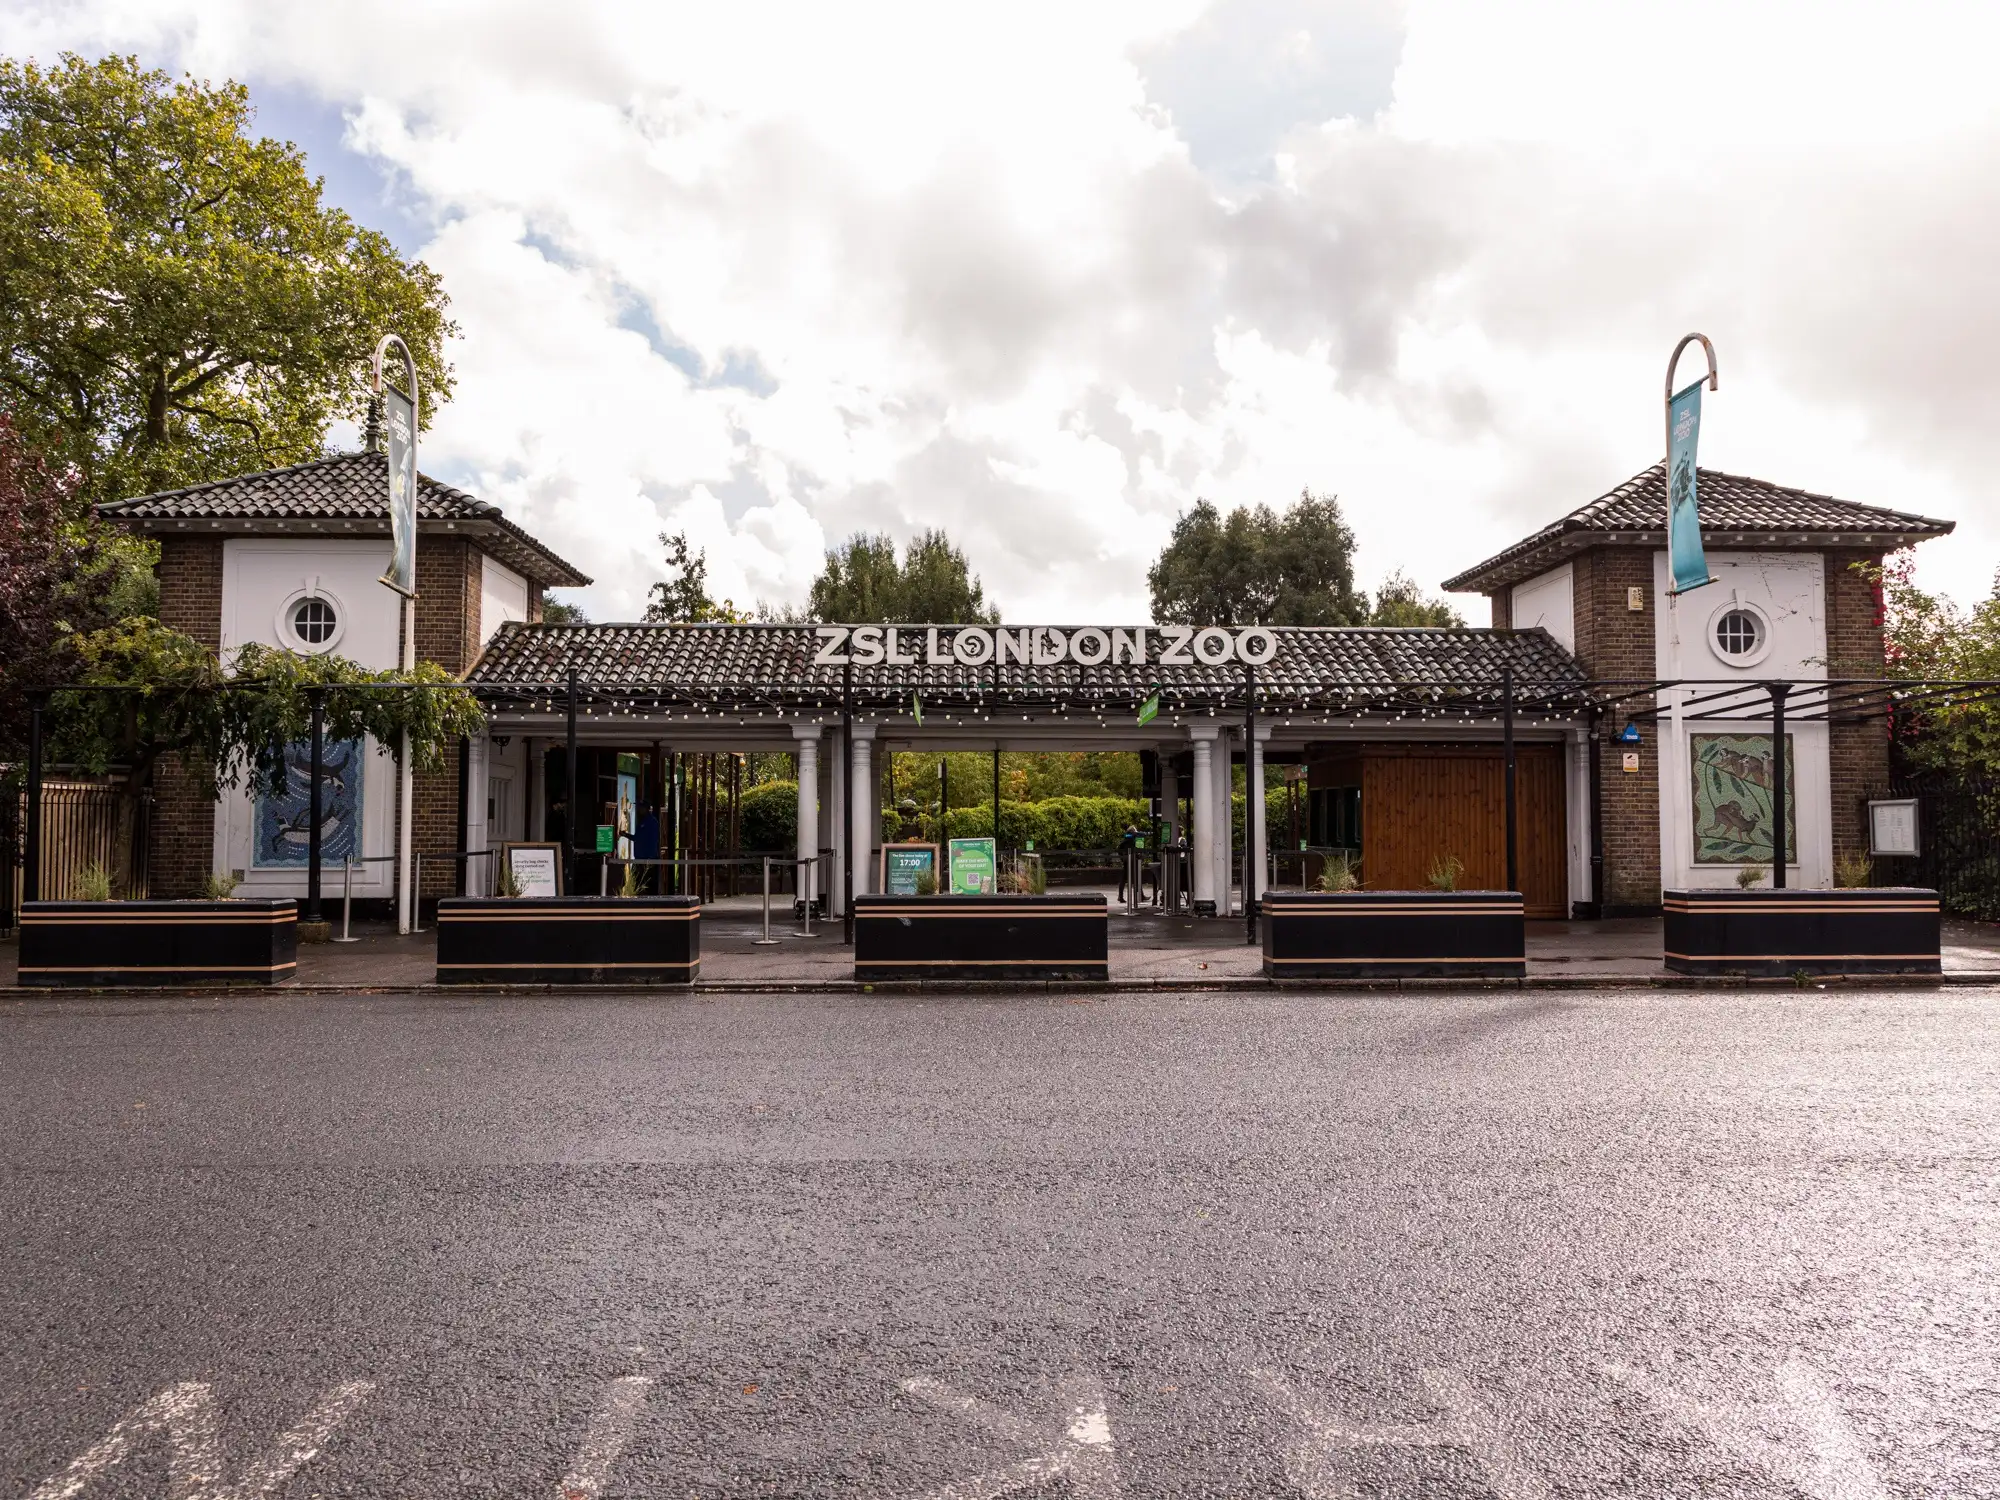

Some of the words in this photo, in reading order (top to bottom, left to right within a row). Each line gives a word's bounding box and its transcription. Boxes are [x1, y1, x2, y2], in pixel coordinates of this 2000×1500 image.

[814, 627, 909, 666] ZSL
[927, 627, 1146, 666] LONDON
[1160, 627, 1277, 666] ZOO
